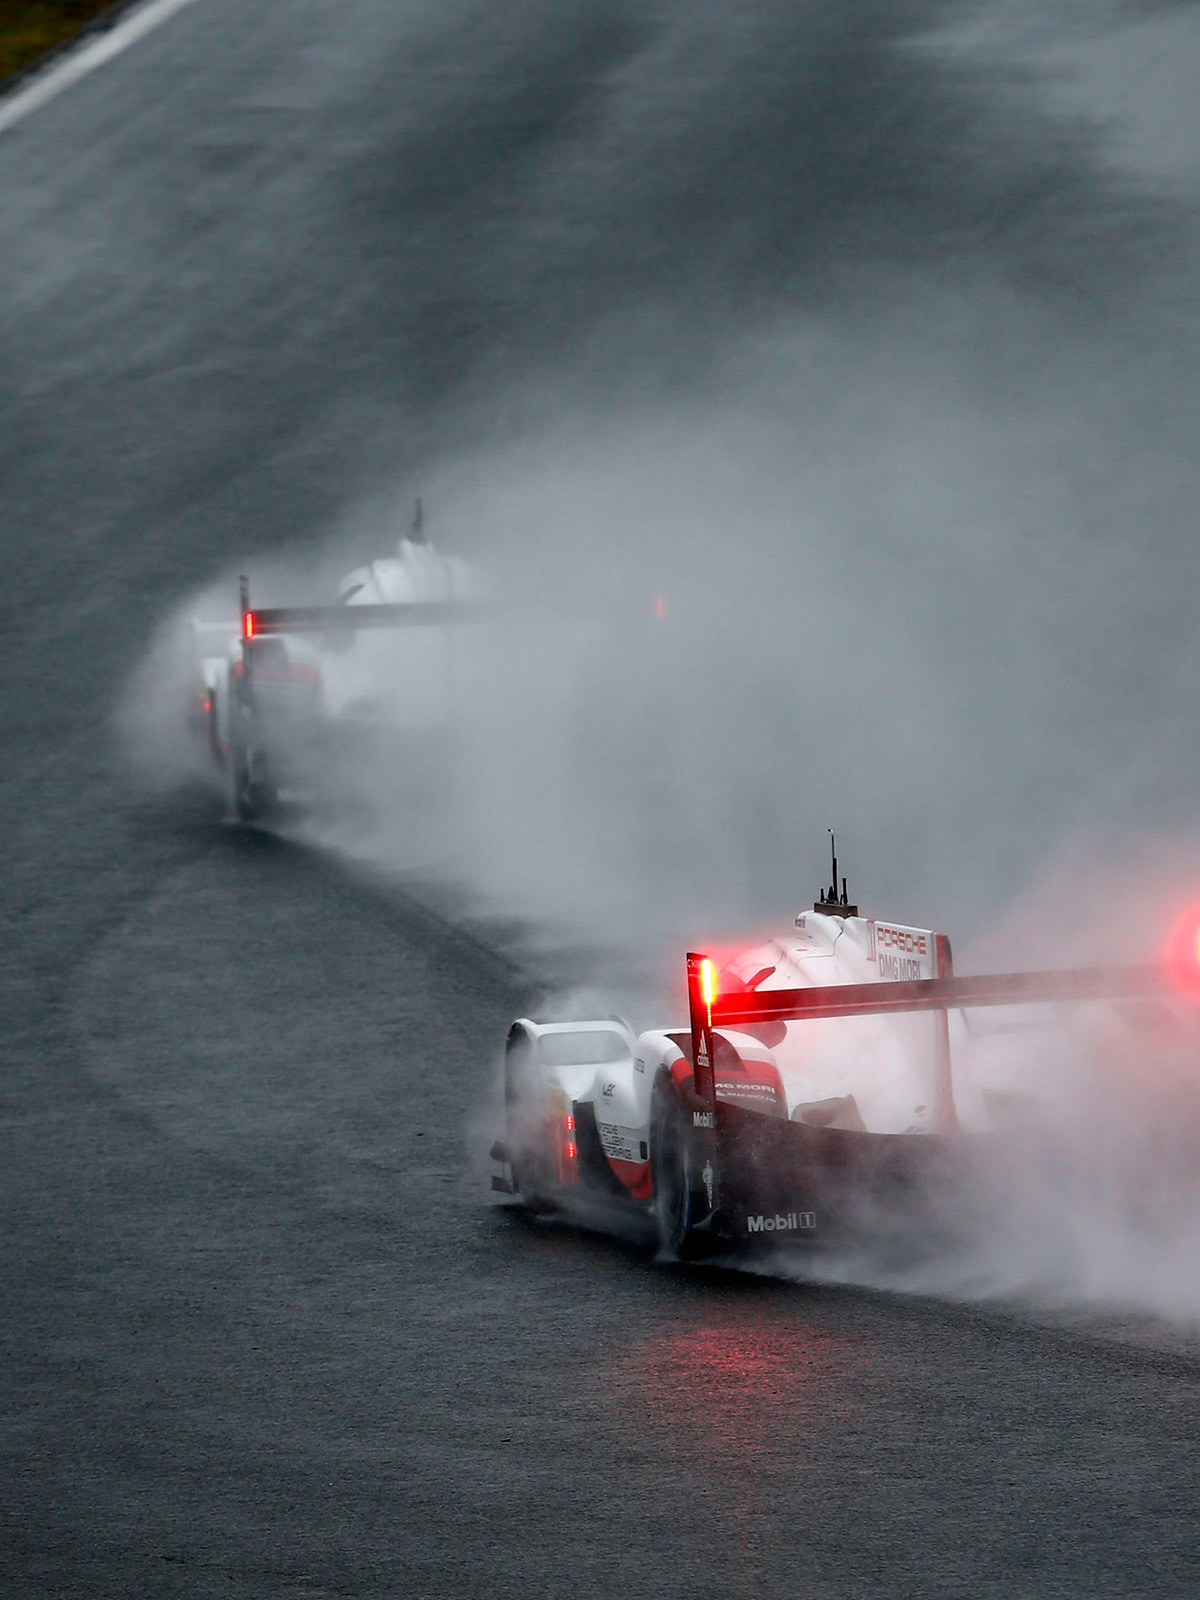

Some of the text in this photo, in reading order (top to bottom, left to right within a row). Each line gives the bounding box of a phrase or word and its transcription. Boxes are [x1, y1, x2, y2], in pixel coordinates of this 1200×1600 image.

[877, 927, 926, 955] PORSCHE
[878, 953, 898, 979] DMG
[737, 1084, 776, 1094] MORI
[747, 1213, 797, 1232] Mobil
